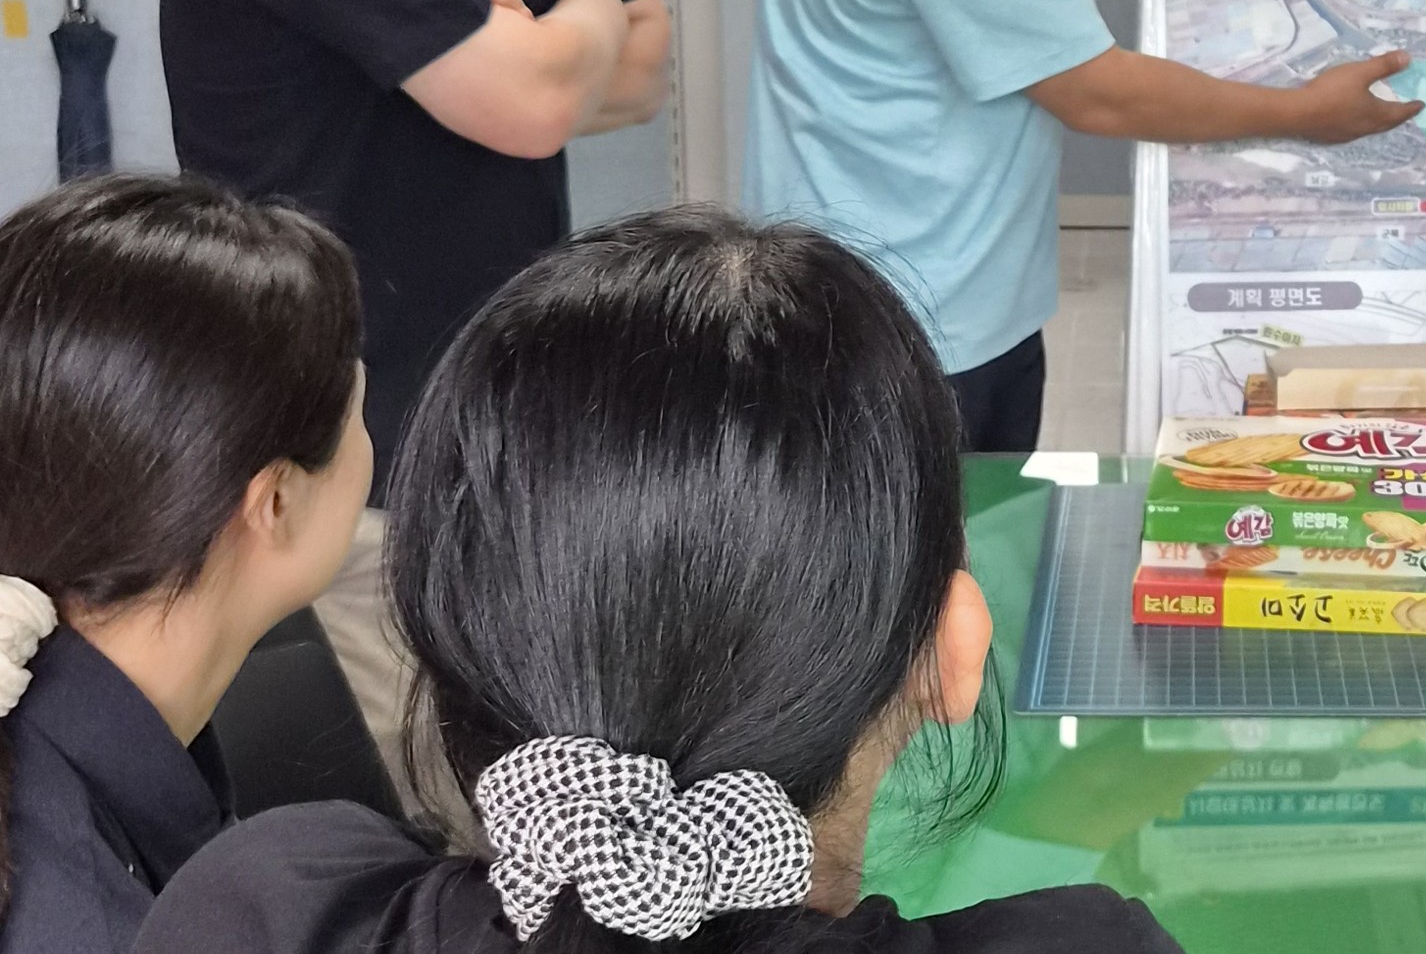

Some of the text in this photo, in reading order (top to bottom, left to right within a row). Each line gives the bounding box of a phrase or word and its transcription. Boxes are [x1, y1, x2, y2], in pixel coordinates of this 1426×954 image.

[1228, 287, 1323, 307] 계획 평면도
[1225, 509, 1274, 541] 예감
[1302, 547, 1396, 571] Cheese
[1144, 594, 1216, 615] 알뜰가격
[1261, 594, 1333, 623] 고소미
